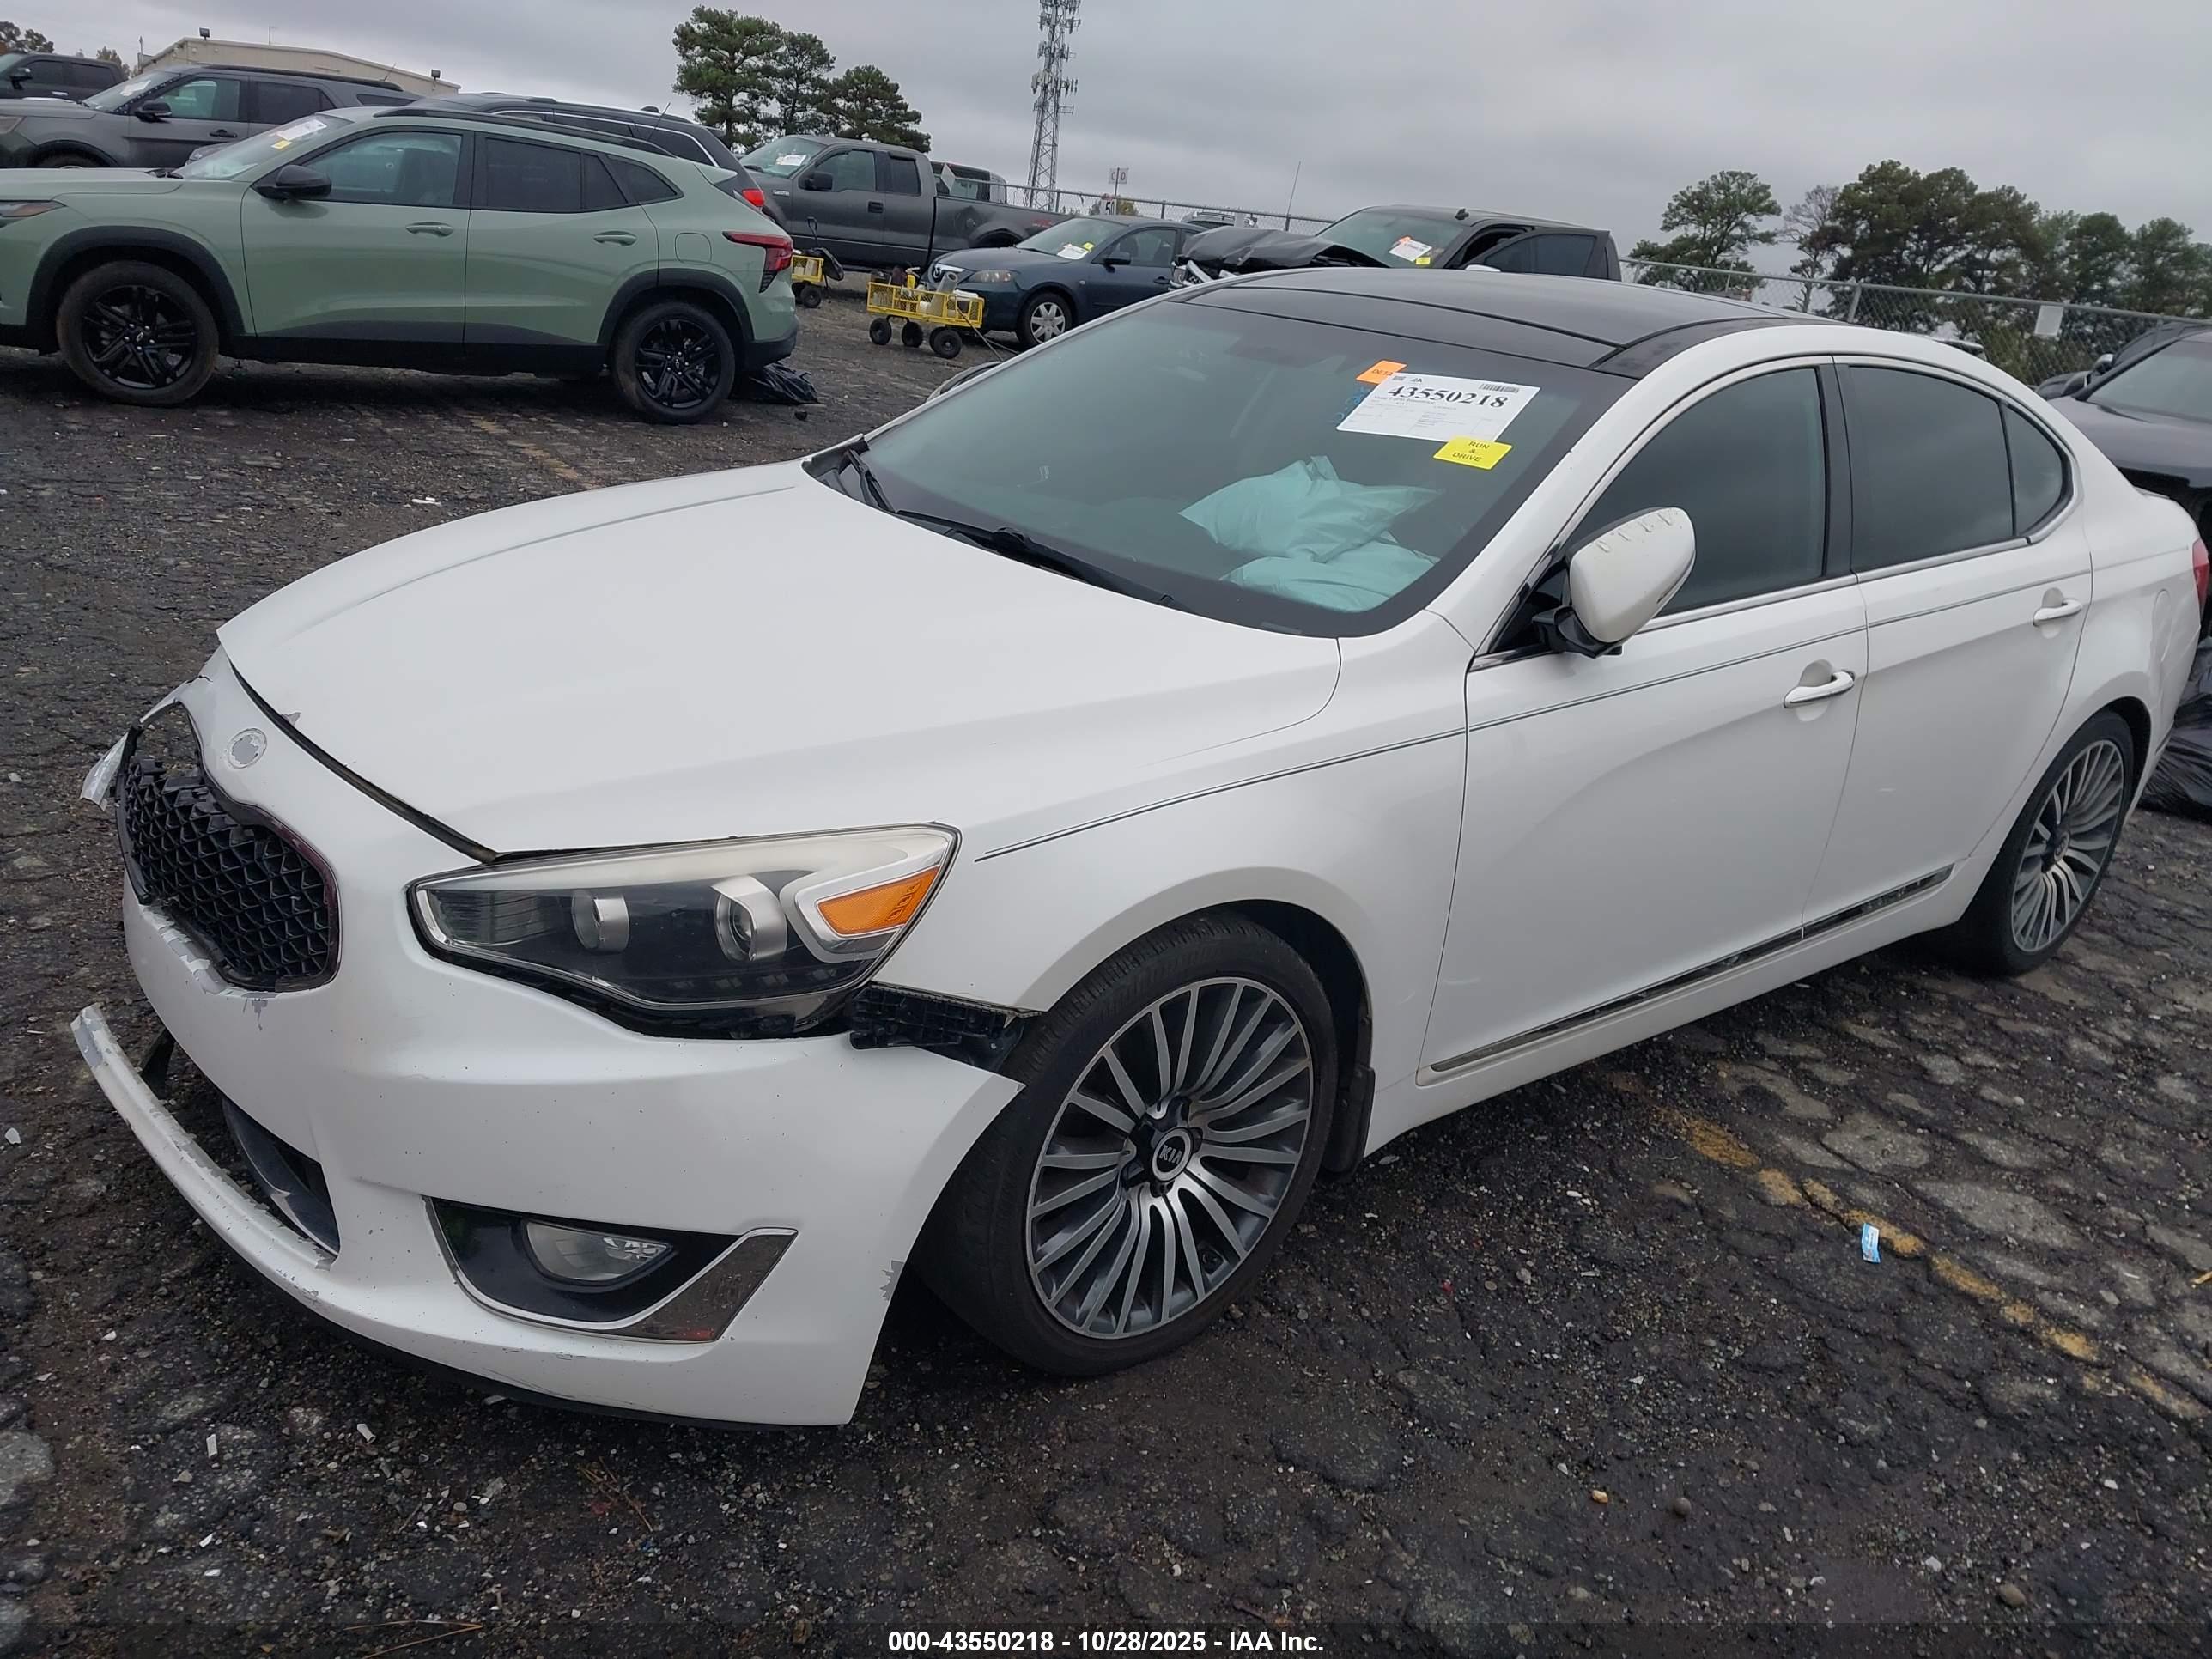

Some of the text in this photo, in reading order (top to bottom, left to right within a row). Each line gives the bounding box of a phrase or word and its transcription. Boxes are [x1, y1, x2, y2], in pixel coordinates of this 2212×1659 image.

[1388, 386, 1509, 408] 43550218
[1468, 441, 1490, 449] RUN
[1452, 452, 1482, 462] DRIVE
